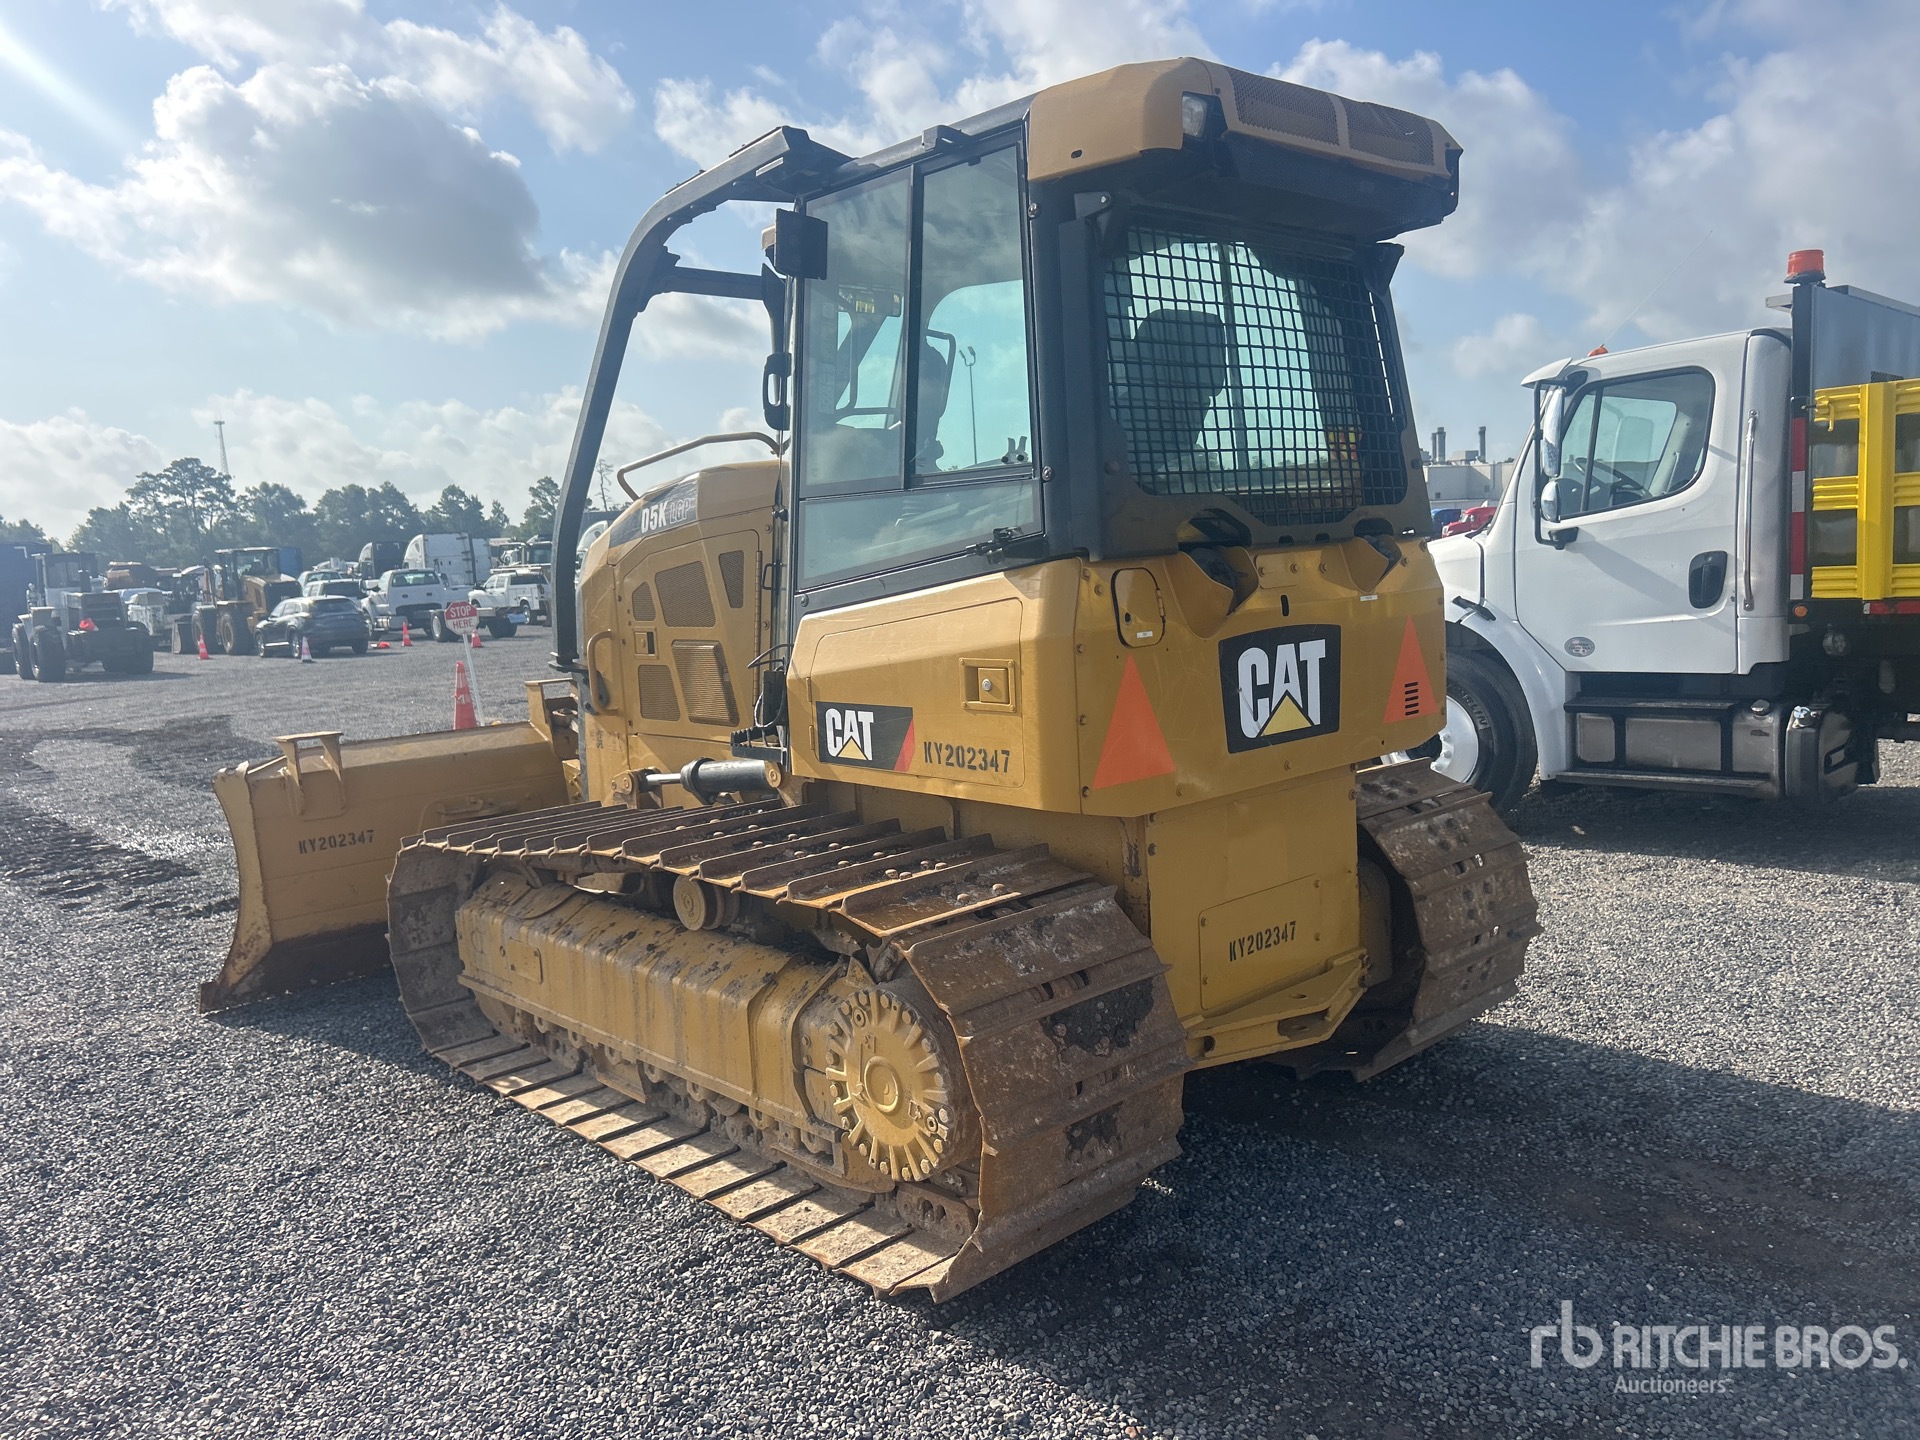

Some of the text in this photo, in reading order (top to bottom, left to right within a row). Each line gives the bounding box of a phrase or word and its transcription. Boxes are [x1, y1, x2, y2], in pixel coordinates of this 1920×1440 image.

[641, 498, 690, 533] D5K LGP
[450, 606, 471, 618] STOP
[453, 619, 473, 629] HERE
[1238, 639, 1326, 738] CAT
[825, 708, 874, 761] CAT
[923, 741, 1010, 773] KY202347
[298, 829, 374, 854] KY202347
[1229, 920, 1296, 962] KY202347
